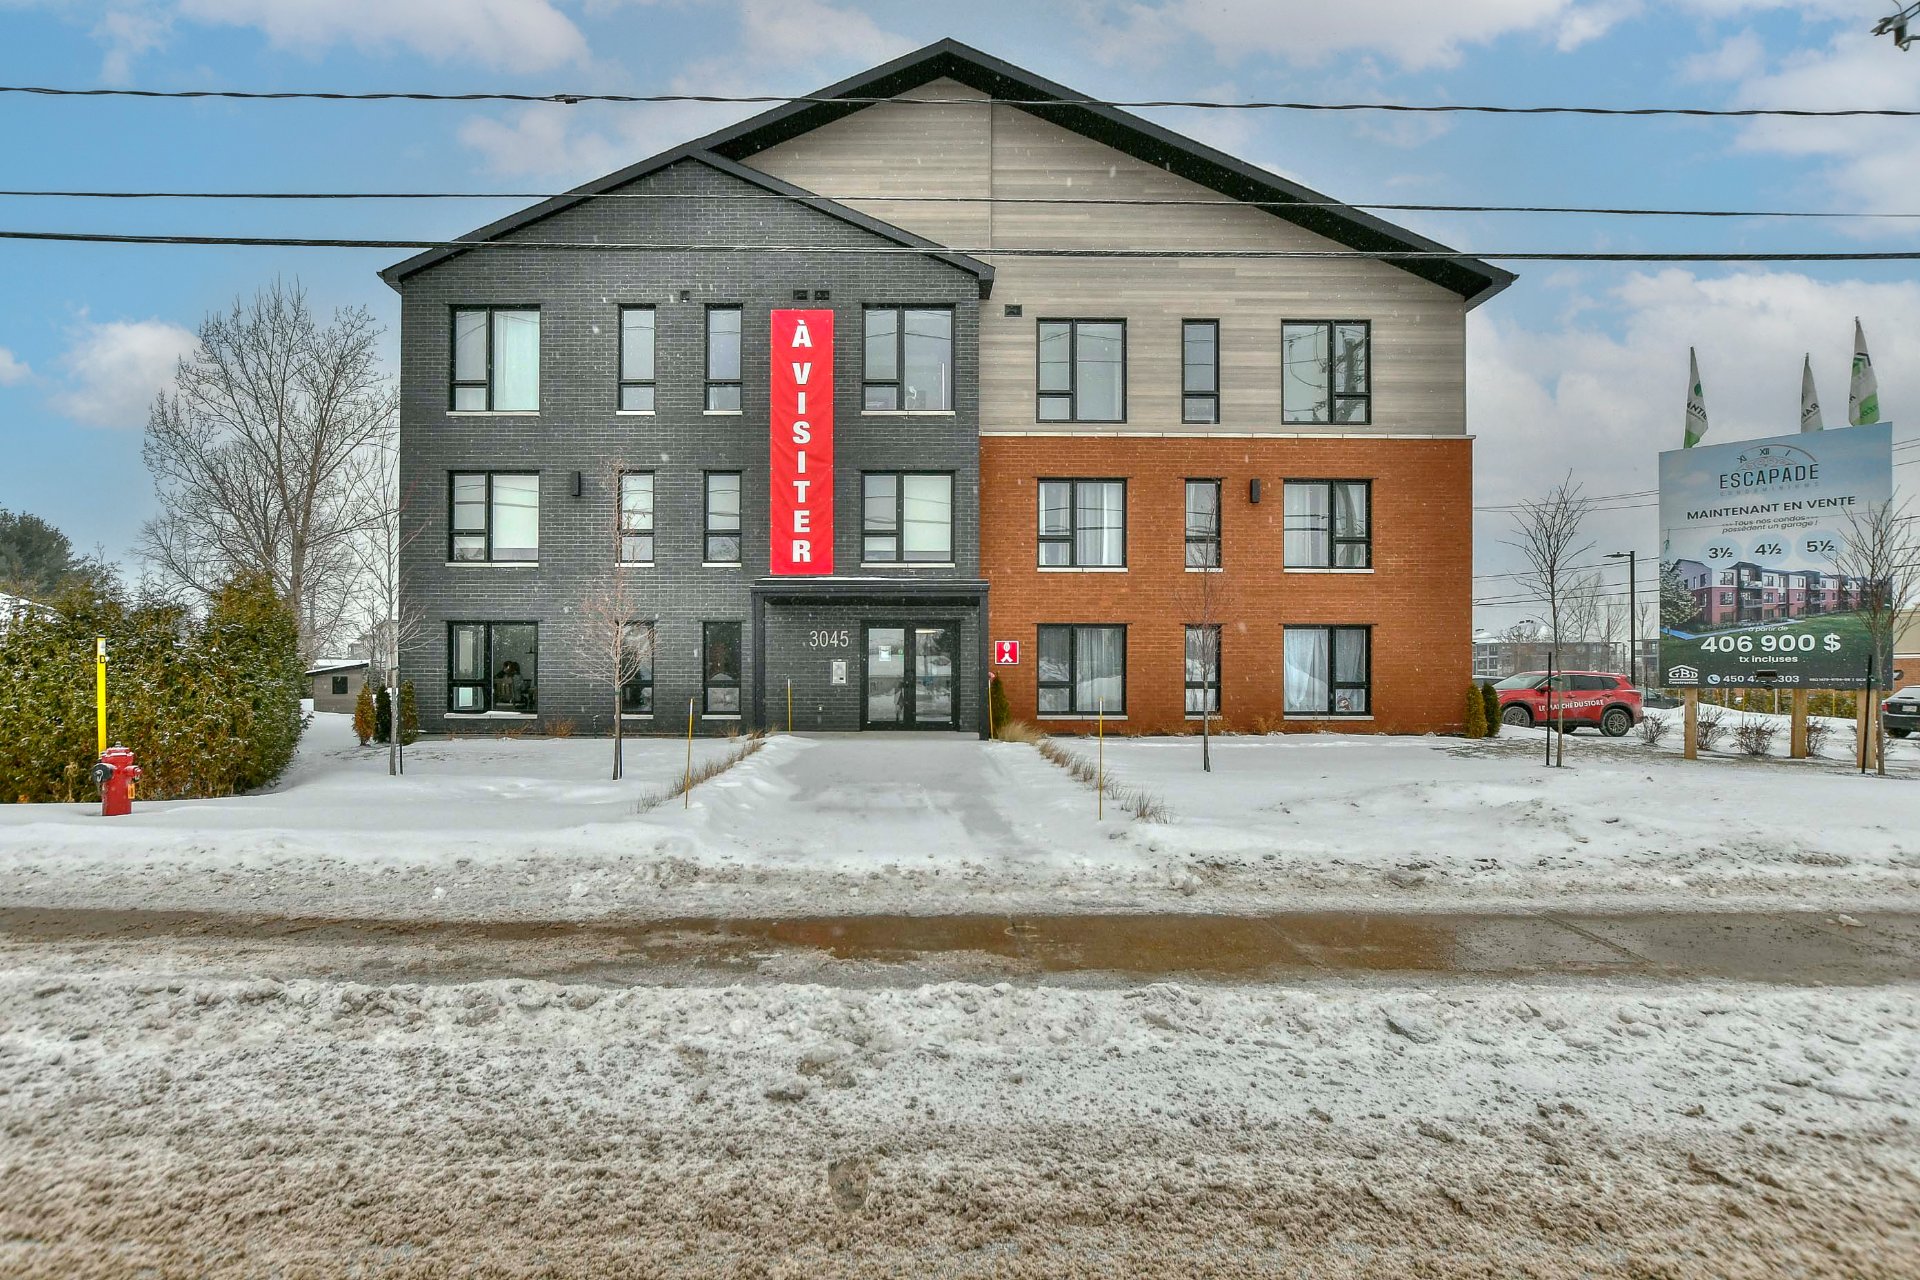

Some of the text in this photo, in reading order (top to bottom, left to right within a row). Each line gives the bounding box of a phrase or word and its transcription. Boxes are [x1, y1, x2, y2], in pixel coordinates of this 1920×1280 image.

[792, 319, 813, 563] À VISITER
[1759, 447, 1770, 456] XII
[1719, 463, 1819, 489] ESCAPADE
[1686, 495, 1856, 520] MAINTENANT EN VENTE
[1773, 515, 1806, 523] condos
[1780, 520, 1814, 530] garage
[1708, 547, 1733, 560] 3½
[1754, 542, 1782, 556] 4½
[809, 630, 849, 647] 3045
[1700, 632, 1841, 653] 406 900 $
[1739, 655, 1798, 663] tx incluses
[1722, 675, 1745, 683] 450
